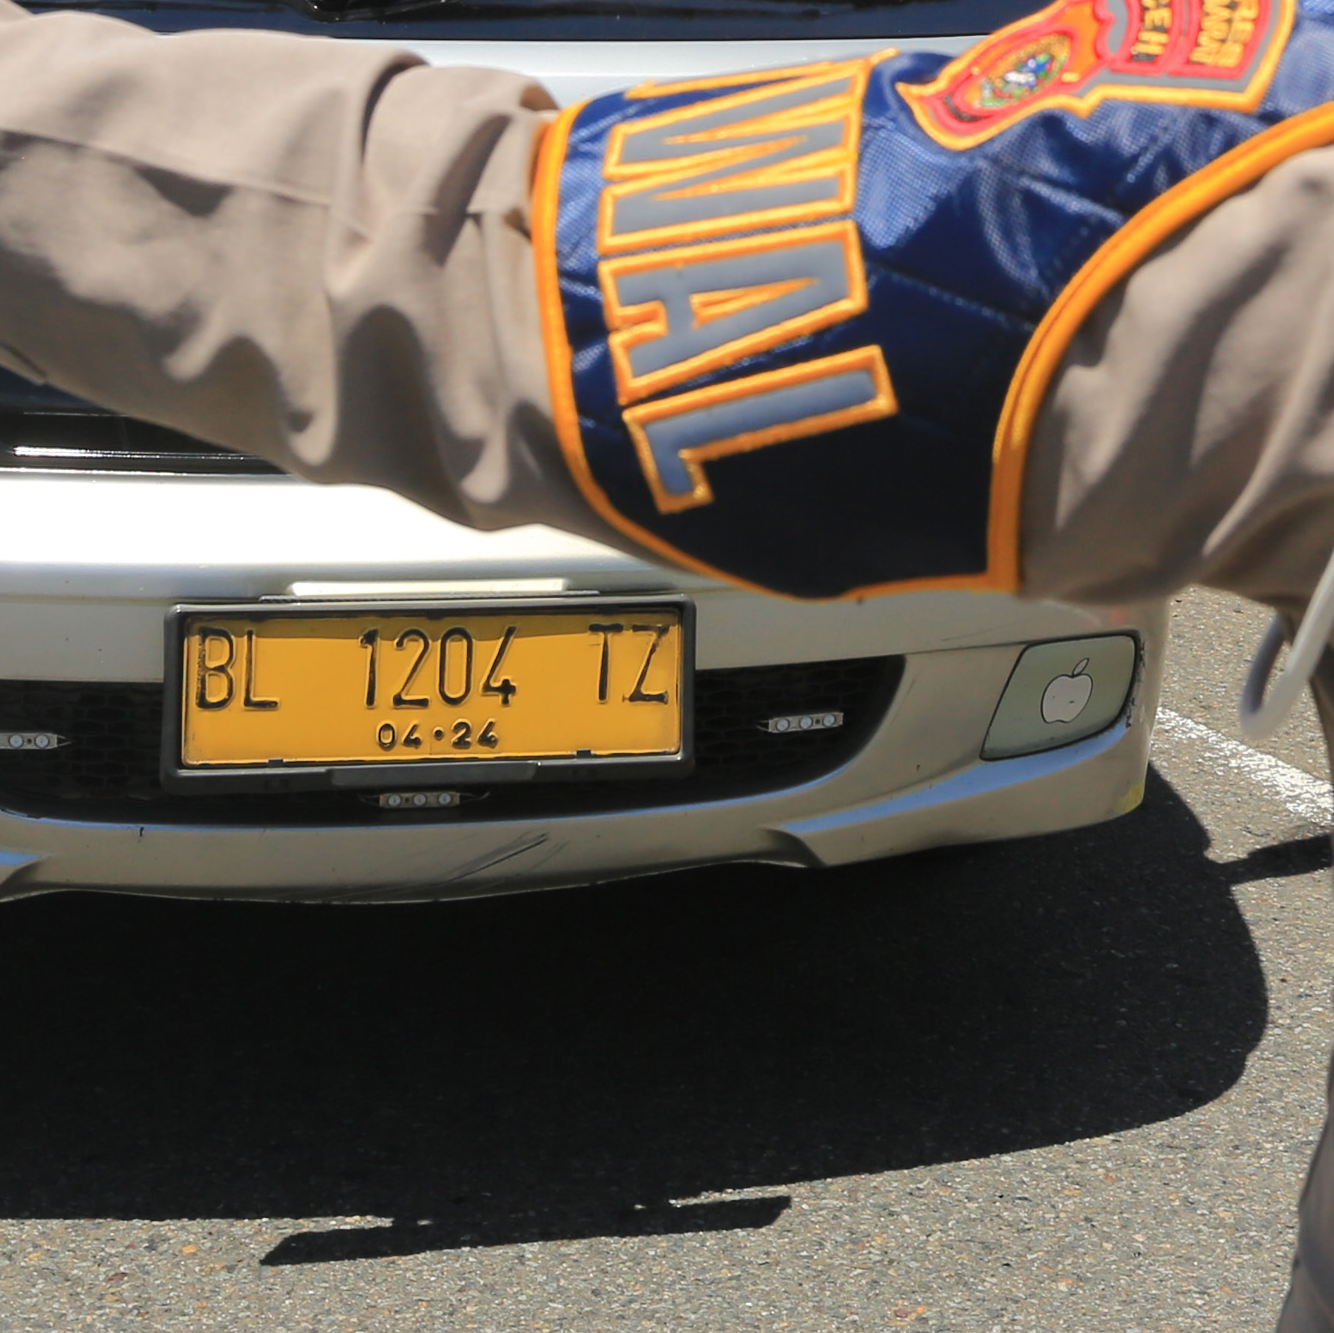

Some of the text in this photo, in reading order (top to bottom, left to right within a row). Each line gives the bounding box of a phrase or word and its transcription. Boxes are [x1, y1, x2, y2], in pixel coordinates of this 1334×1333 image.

[597, 48, 900, 514] WAL
[195, 621, 670, 710] BL 1204 TZ
